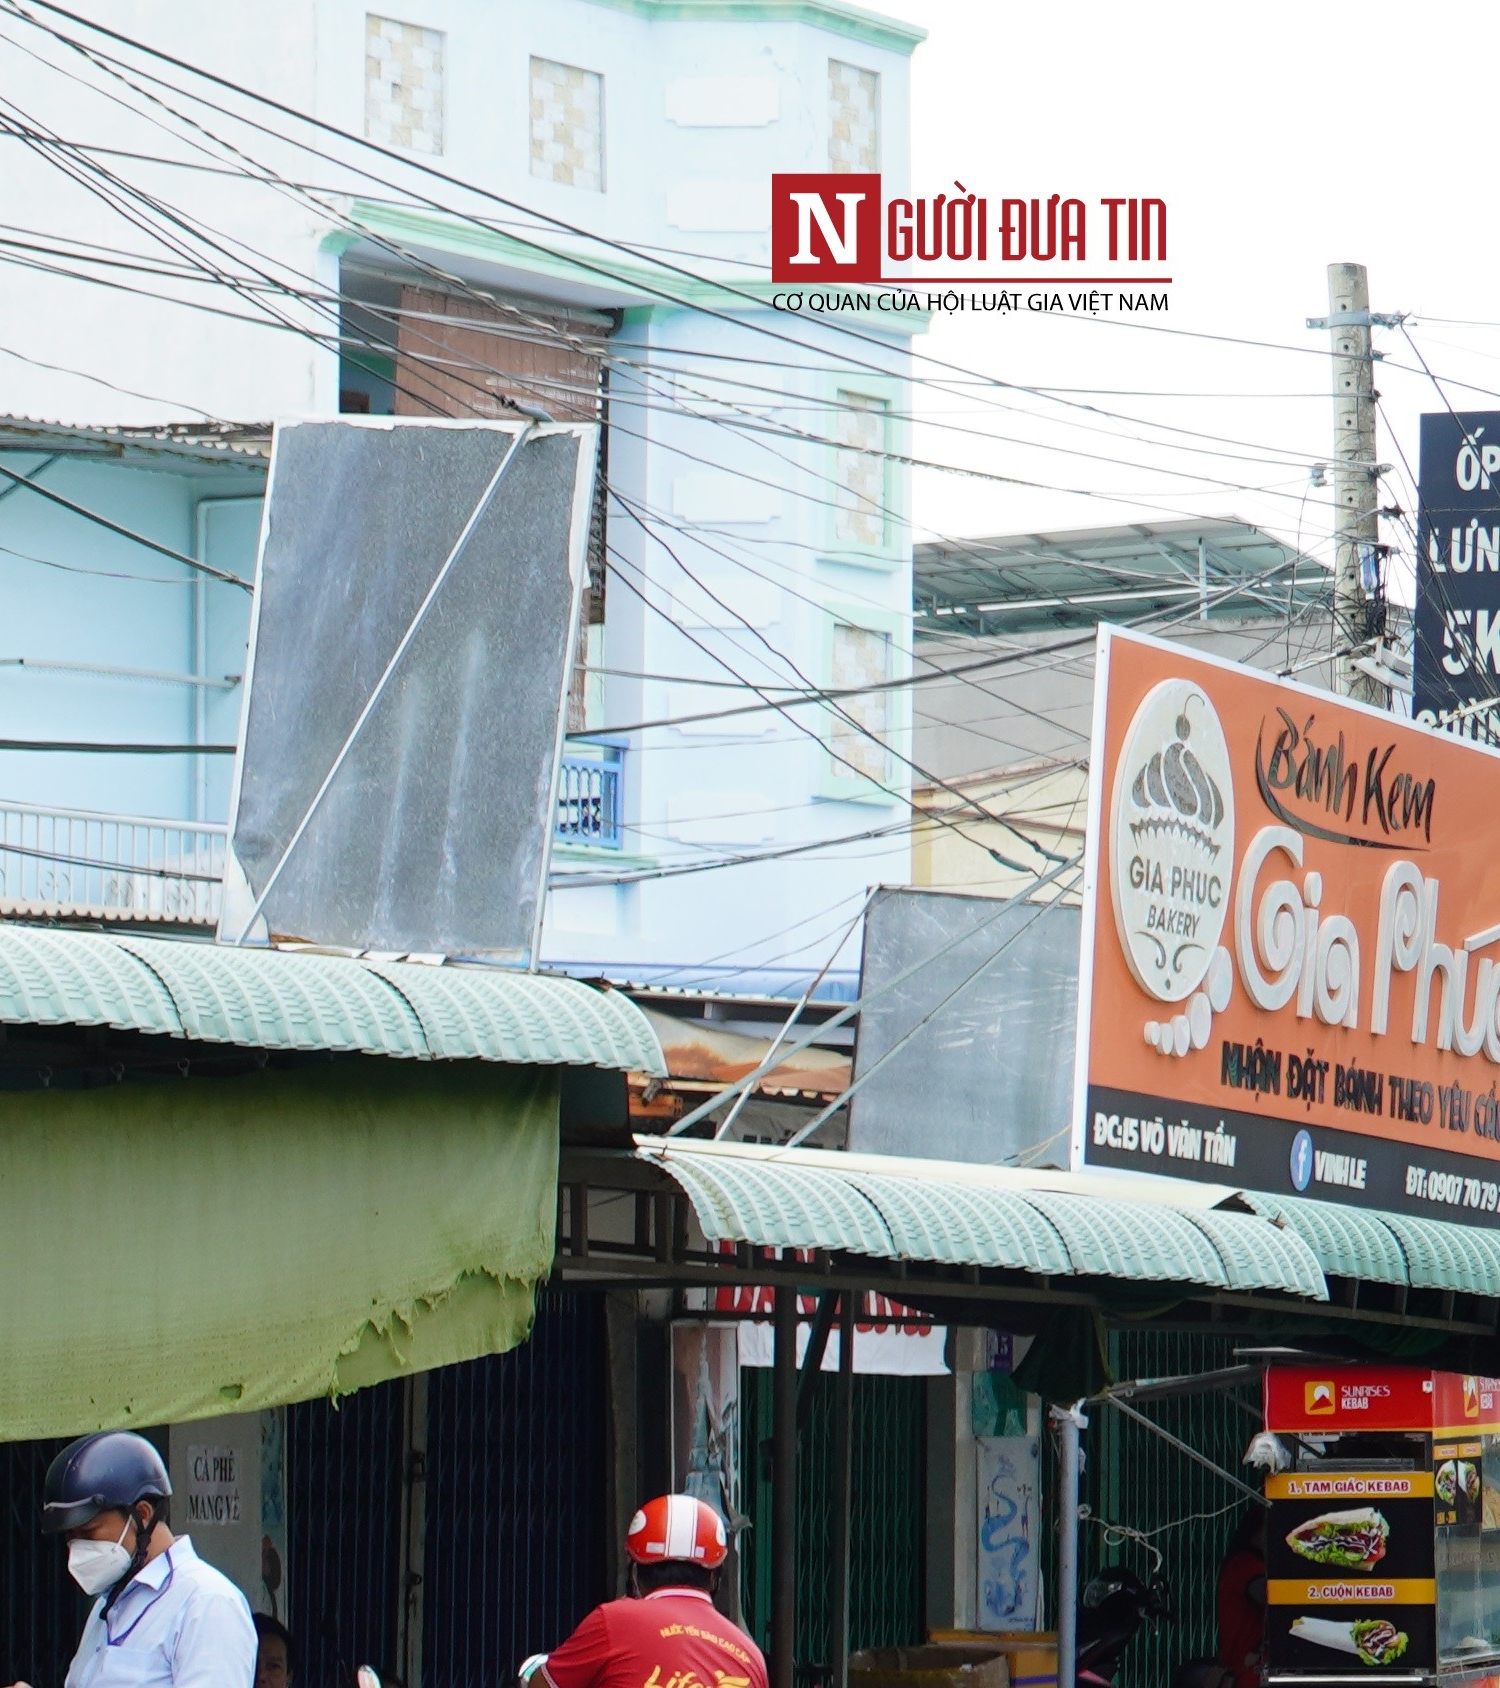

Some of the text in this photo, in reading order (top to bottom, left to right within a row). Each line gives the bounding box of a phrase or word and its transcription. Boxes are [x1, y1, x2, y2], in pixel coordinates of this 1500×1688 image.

[1266, 706, 1358, 822] Bánh
[1362, 743, 1437, 844] Kem
[1129, 855, 1164, 896] GIA
[1146, 905, 1200, 939] BAKERY
[1234, 826, 1359, 1030] Gia
[1220, 1041, 1500, 1143] NHẬN ĐẶT BÁNH THEO YÊU CẦ
[1140, 1117, 1163, 1157] VÕ
[1168, 1124, 1201, 1162] VĂN
[1341, 1386, 1390, 1398] SUNRISES
[1341, 1398, 1368, 1410] KEBAB
[1304, 1482, 1331, 1493] TAM
[1334, 1478, 1364, 1492] GIÁC
[1367, 1481, 1409, 1493] KEBAB
[186, 1494, 224, 1521] MANG
[1309, 1583, 1393, 1600] 2. CUỘN KEBAB
